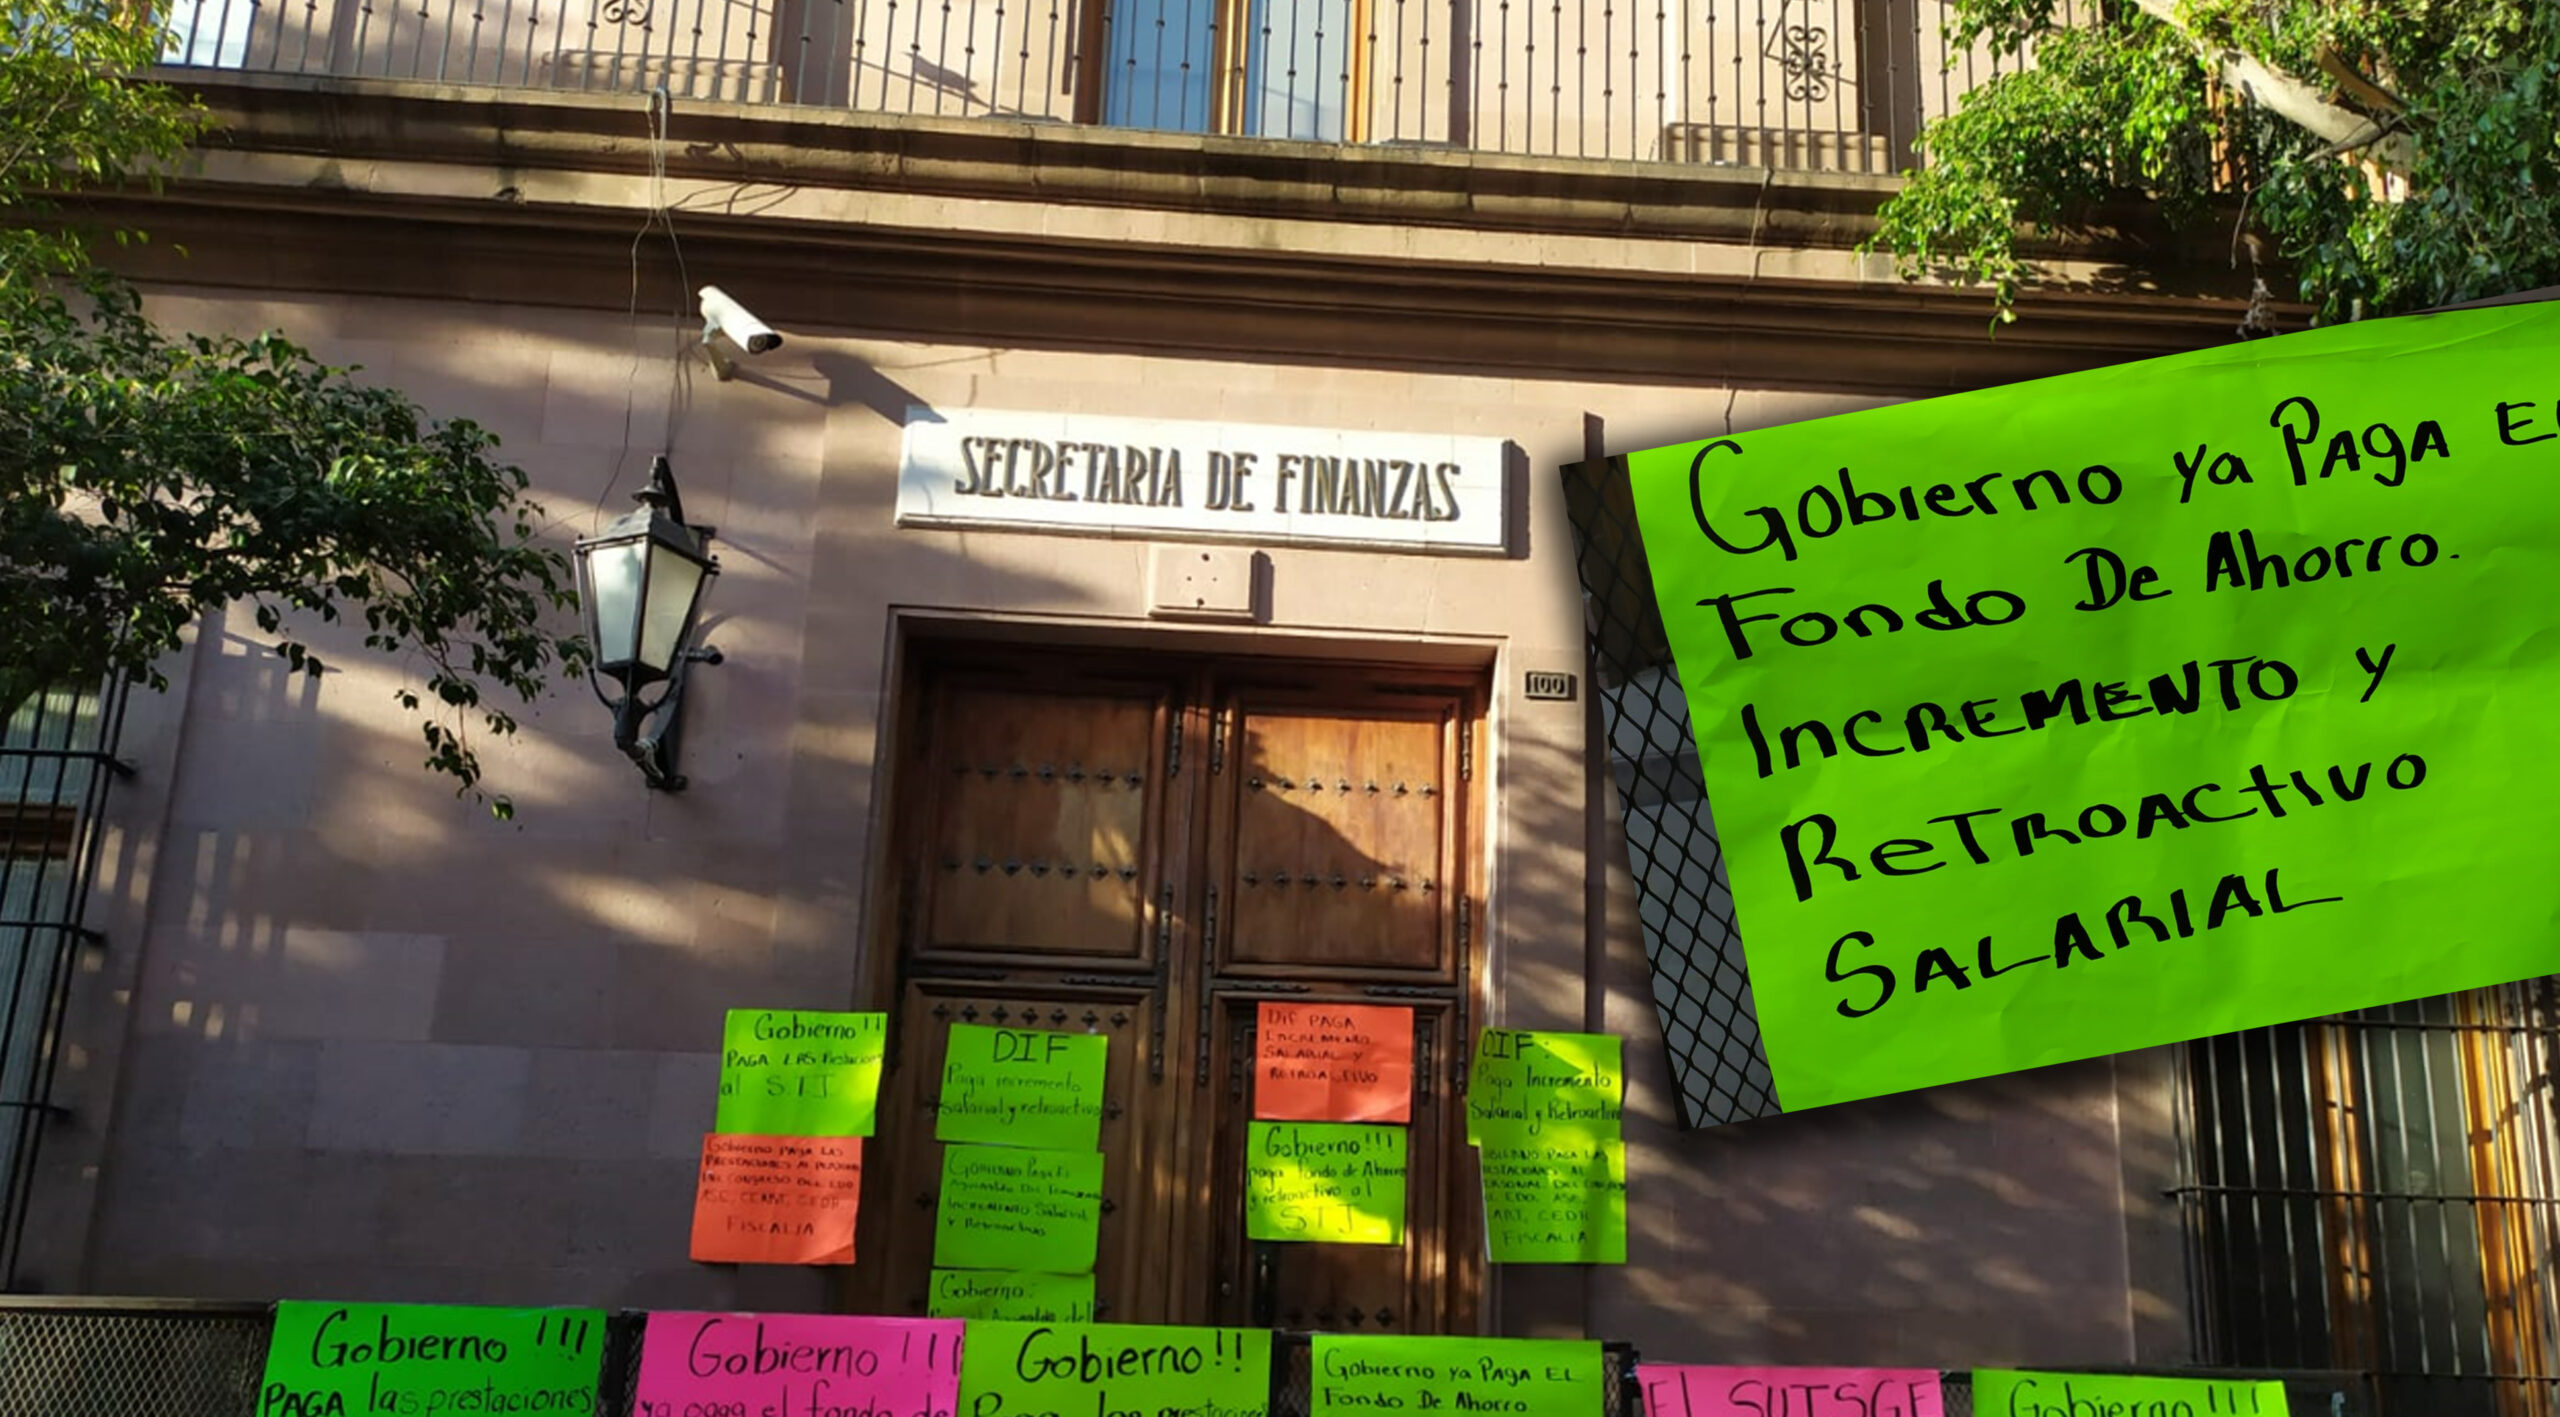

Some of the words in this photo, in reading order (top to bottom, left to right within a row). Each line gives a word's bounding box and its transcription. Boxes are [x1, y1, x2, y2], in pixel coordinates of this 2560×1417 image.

[954, 434, 1185, 509] SECRETARIA
[1204, 449, 1258, 513] DE
[1273, 452, 1461, 522] FINANZAS
[1688, 437, 2123, 562] Gobierno
[1696, 579, 2027, 661] Fondo
[2063, 545, 2174, 612] De
[1529, 674, 1568, 697] 100
[1824, 867, 2344, 1018] SALARIAL
[1309, 1014, 1356, 1030] PAGA
[993, 1030, 1071, 1064] DIF
[1323, 1347, 1435, 1382] Gobierno
[263, 1382, 346, 1417] PAGA
[1323, 1386, 1404, 1409] Fondo
